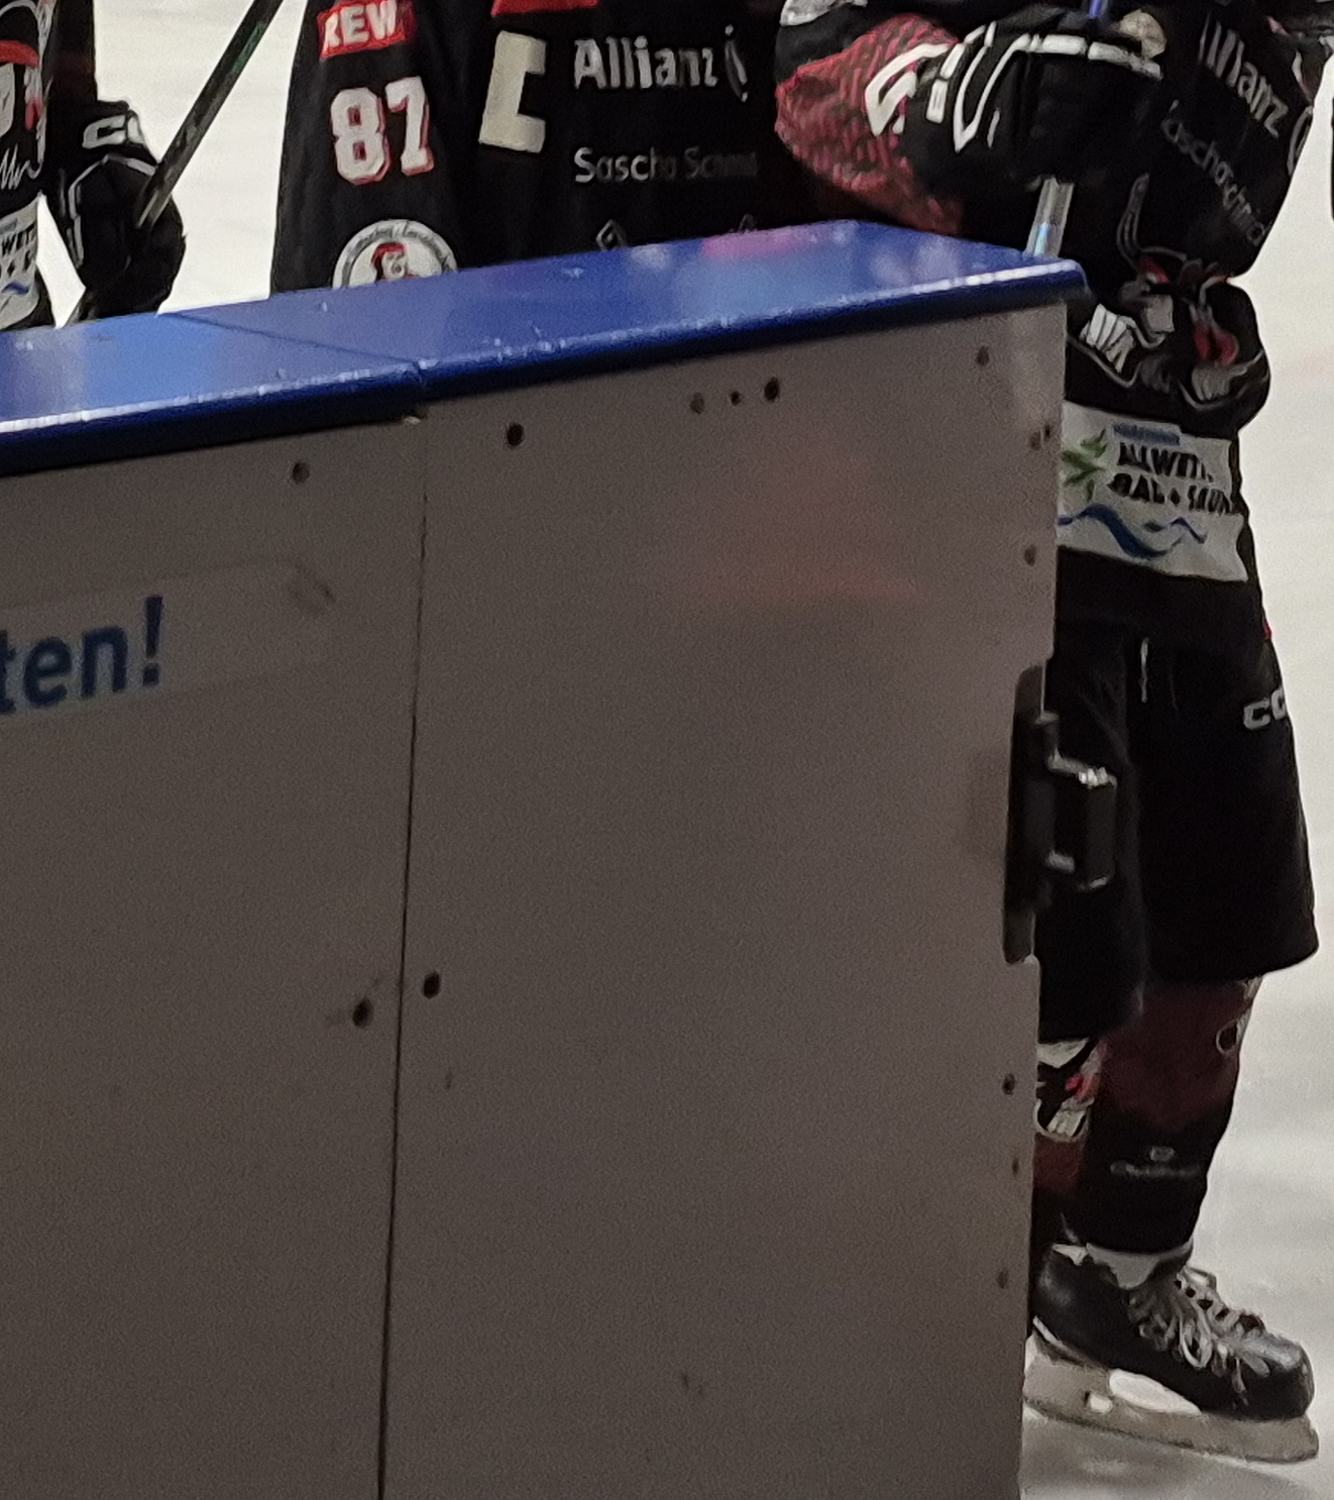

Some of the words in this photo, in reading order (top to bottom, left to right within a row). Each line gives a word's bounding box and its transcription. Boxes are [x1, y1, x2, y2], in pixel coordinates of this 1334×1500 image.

[479, 31, 546, 155] C
[573, 35, 719, 90] Allianz
[1197, 11, 1291, 139] llianz
[330, 76, 435, 185] 87
